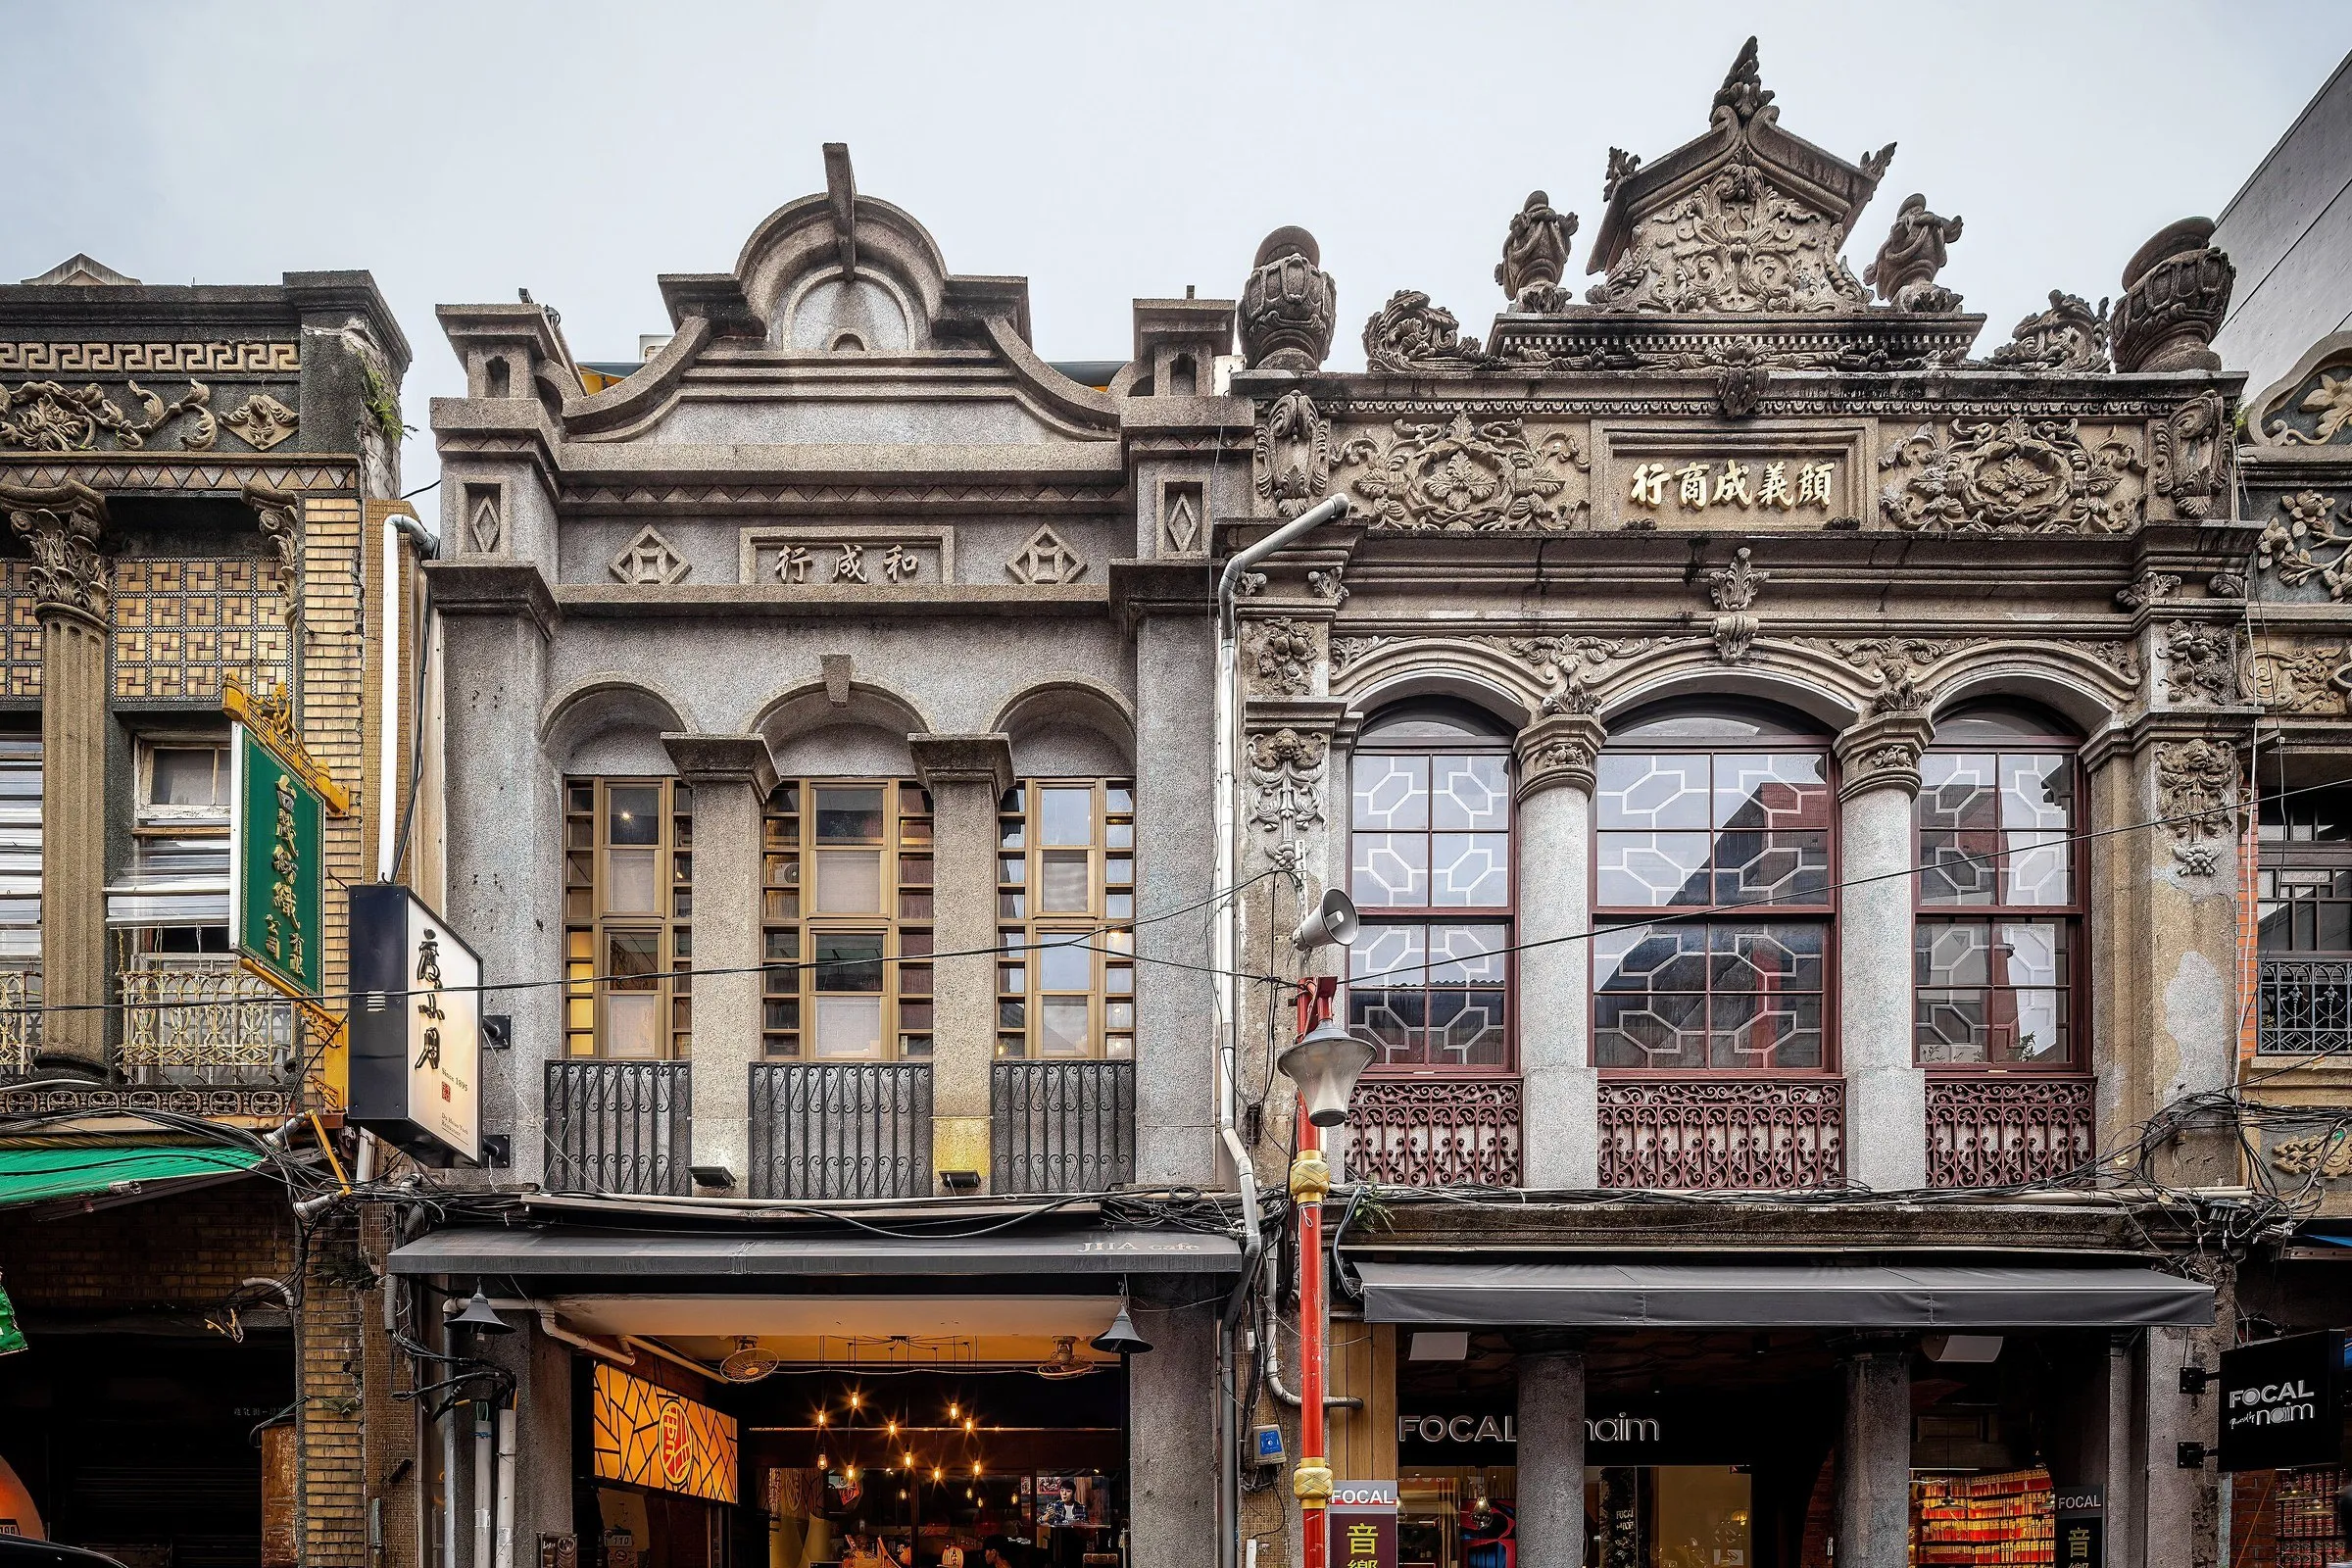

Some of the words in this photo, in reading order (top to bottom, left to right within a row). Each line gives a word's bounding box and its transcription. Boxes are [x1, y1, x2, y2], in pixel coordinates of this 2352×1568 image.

[455, 1077, 468, 1092] 1895
[2229, 1379, 2315, 1408] FOCAL
[2256, 1401, 2314, 1426] naim
[1398, 1414, 1517, 1442] FOCAL
[1331, 1489, 1395, 1504] FOCAL
[2058, 1494, 2102, 1509] FOCAL
[1347, 1522, 1379, 1568] 音
[2068, 1527, 2090, 1568] 音
